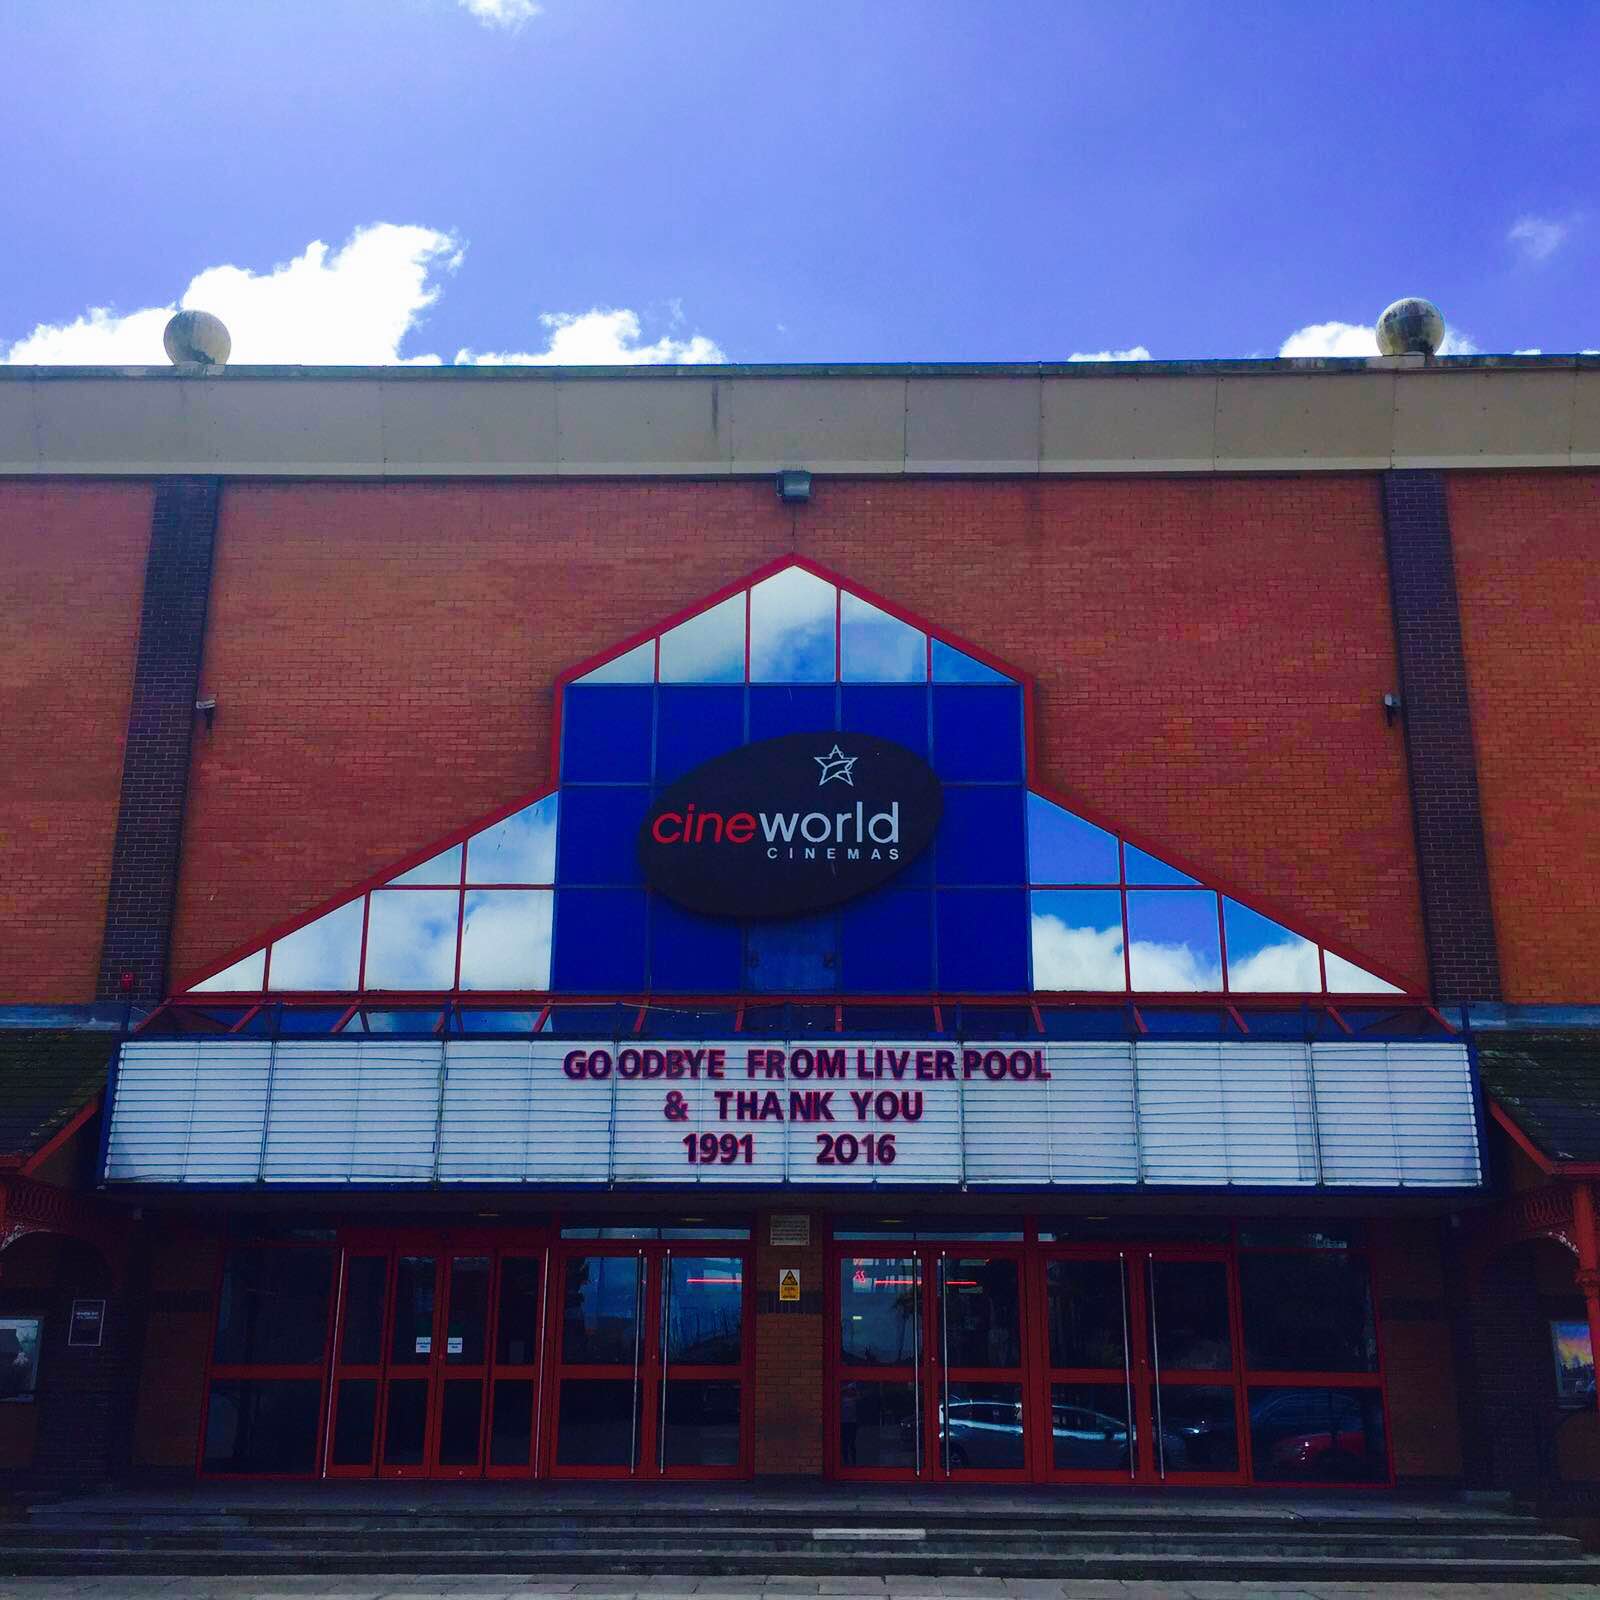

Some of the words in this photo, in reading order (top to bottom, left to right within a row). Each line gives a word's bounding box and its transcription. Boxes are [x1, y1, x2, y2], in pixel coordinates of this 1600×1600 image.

[652, 801, 899, 844] cineworld
[767, 847, 900, 860] CINEMAS
[563, 1049, 725, 1080] GOODBYE
[747, 1049, 846, 1079] FROM
[856, 1049, 1051, 1080] LIVERPOOL
[664, 1091, 689, 1121] &
[714, 1090, 835, 1121] THANK
[849, 1091, 924, 1121] YOU
[682, 1133, 754, 1164] 1991
[815, 1133, 897, 1164] 2016
